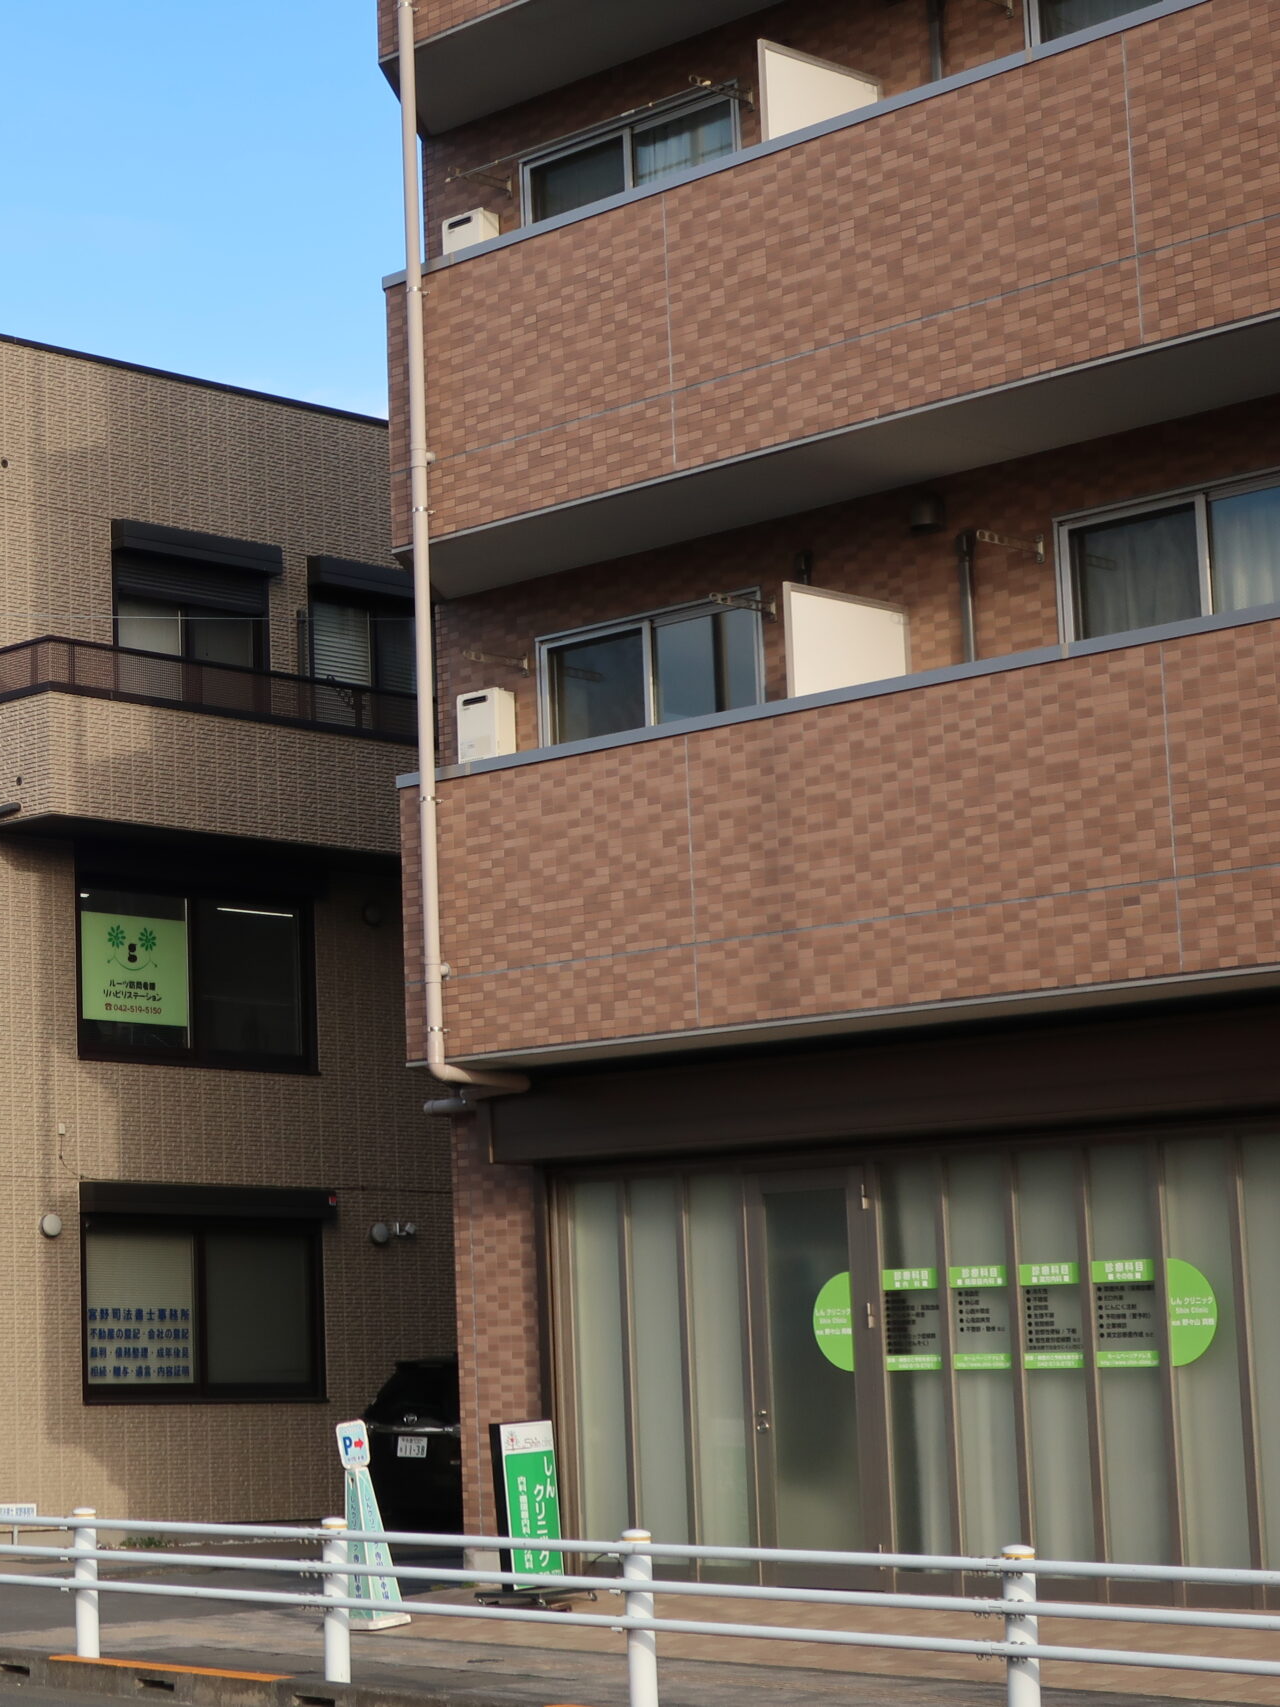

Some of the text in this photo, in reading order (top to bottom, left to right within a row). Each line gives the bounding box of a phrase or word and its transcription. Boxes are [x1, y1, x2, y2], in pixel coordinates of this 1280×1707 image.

[104, 989, 162, 1001] リハビリステーション
[1184, 1296, 1214, 1305] クリニック
[342, 1436, 353, 1456] P
[543, 1456, 555, 1498] しん
[534, 1484, 550, 1567] クリニク
